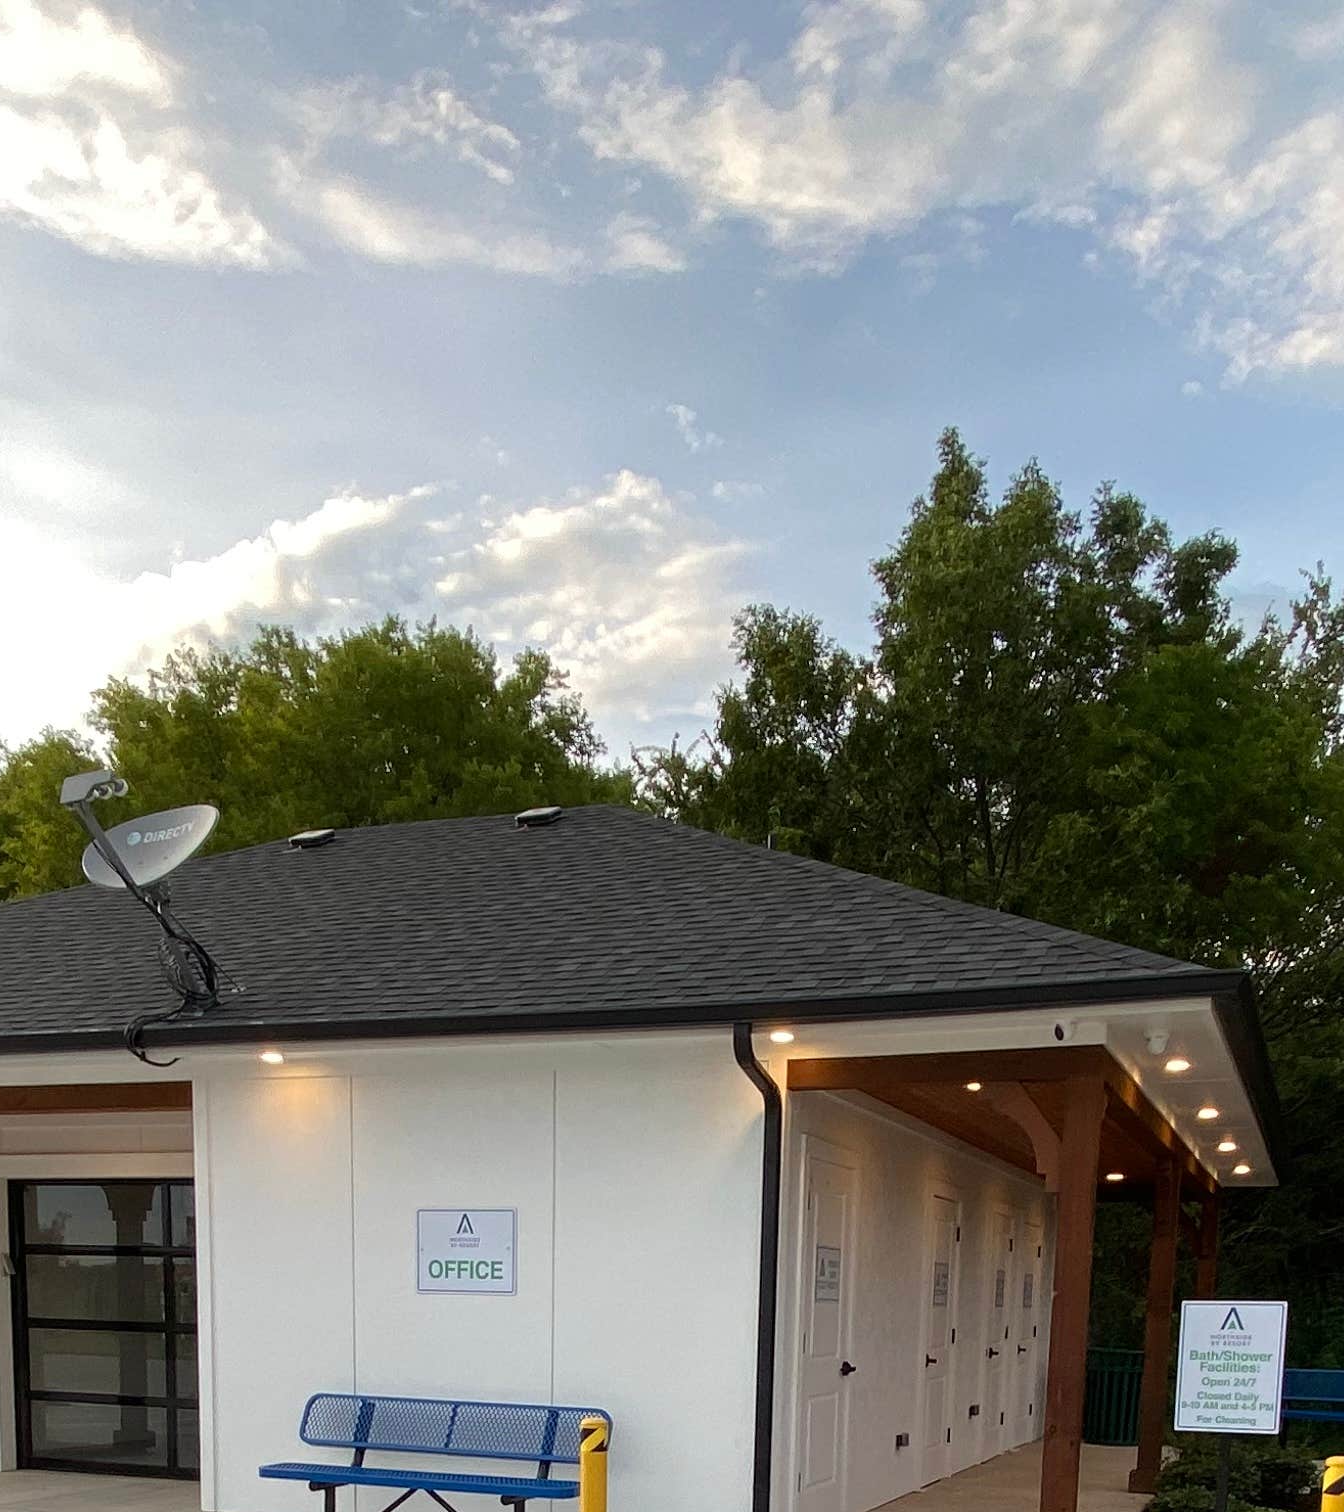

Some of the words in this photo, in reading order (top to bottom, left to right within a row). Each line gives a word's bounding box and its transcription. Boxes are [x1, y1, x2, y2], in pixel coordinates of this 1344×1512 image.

[143, 822, 194, 843] DIRECTV
[428, 1259, 504, 1280] OFFICE
[1189, 1350, 1273, 1362] Bath/Shower
[1200, 1361, 1261, 1374] Facilities:
[1201, 1376, 1231, 1388] Open
[1233, 1377, 1257, 1388] 24/7
[1196, 1391, 1232, 1401] Closed
[1234, 1392, 1260, 1404] Daily
[1202, 1401, 1219, 1410] AM
[1220, 1402, 1239, 1410] and
[1259, 1403, 1274, 1412] PM
[1196, 1415, 1212, 1424] For
[1215, 1416, 1257, 1427] Cleaning
